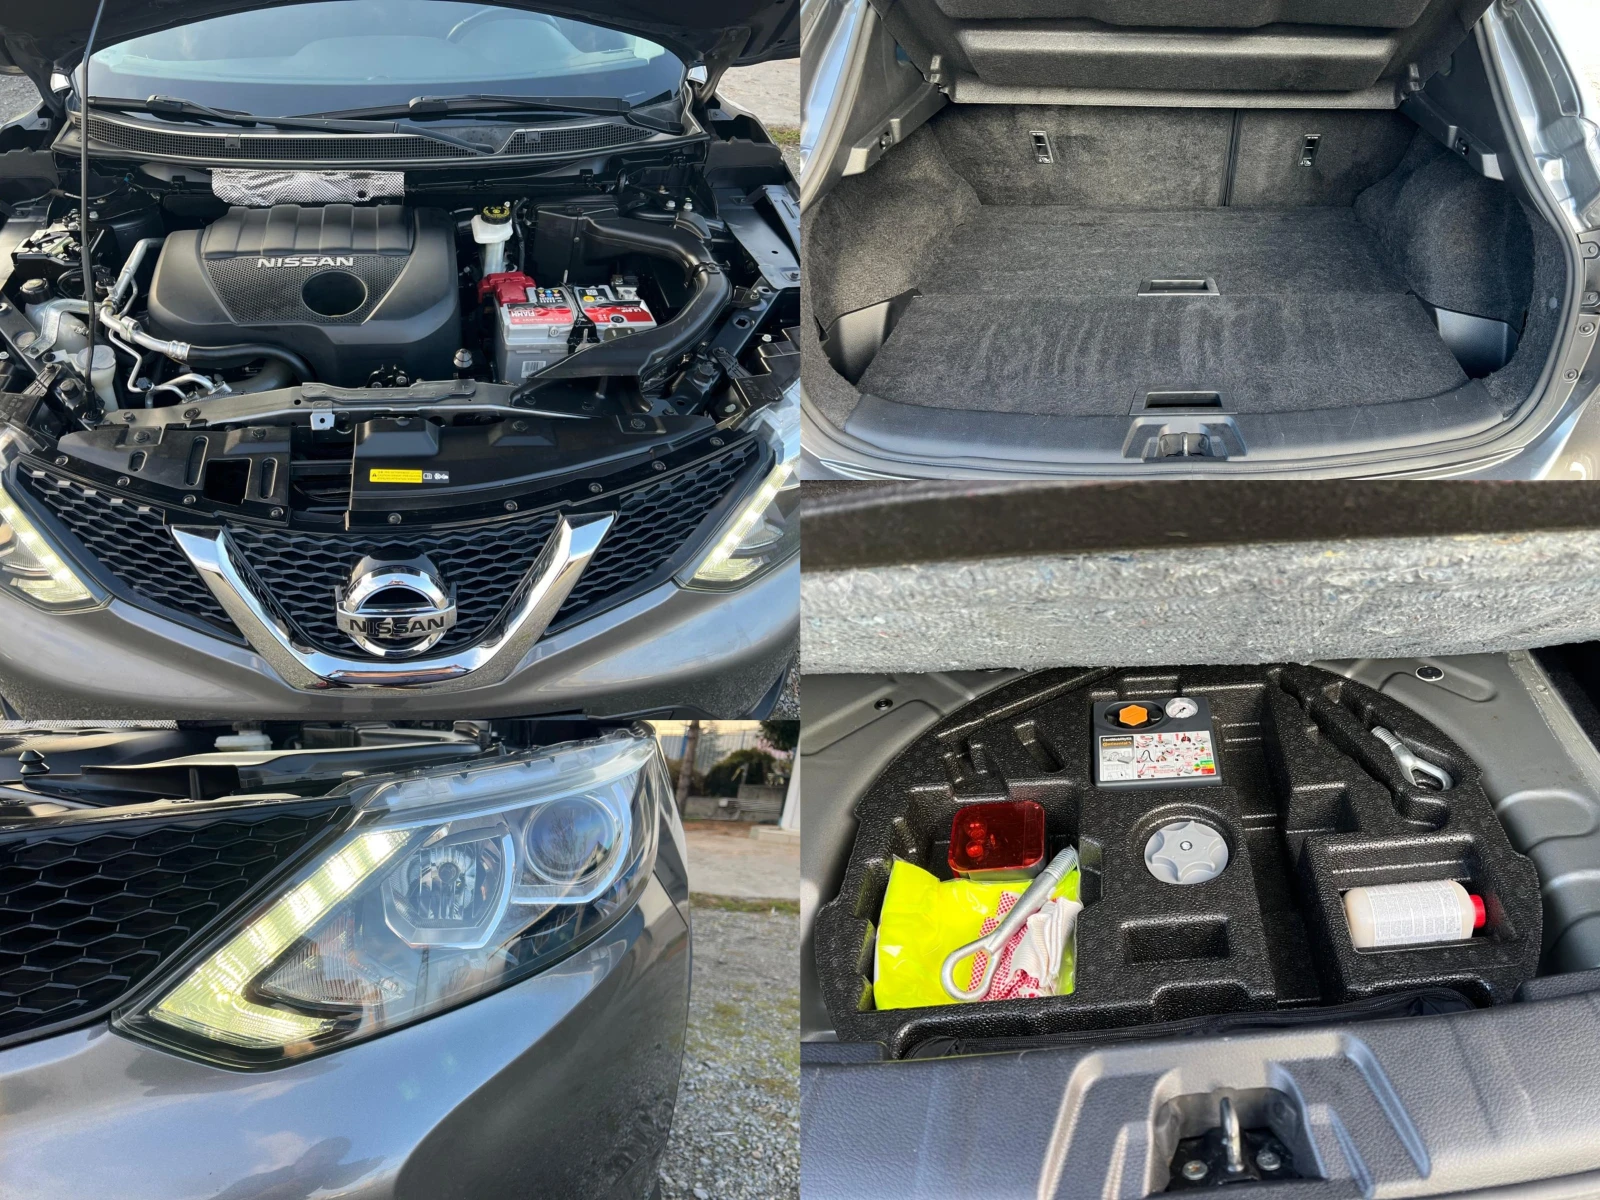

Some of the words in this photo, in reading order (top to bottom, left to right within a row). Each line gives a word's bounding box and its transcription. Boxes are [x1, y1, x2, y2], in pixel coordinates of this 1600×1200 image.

[257, 257, 354, 268] NISSAN
[510, 309, 536, 317] FIAMM
[349, 616, 445, 634] NISSAN
